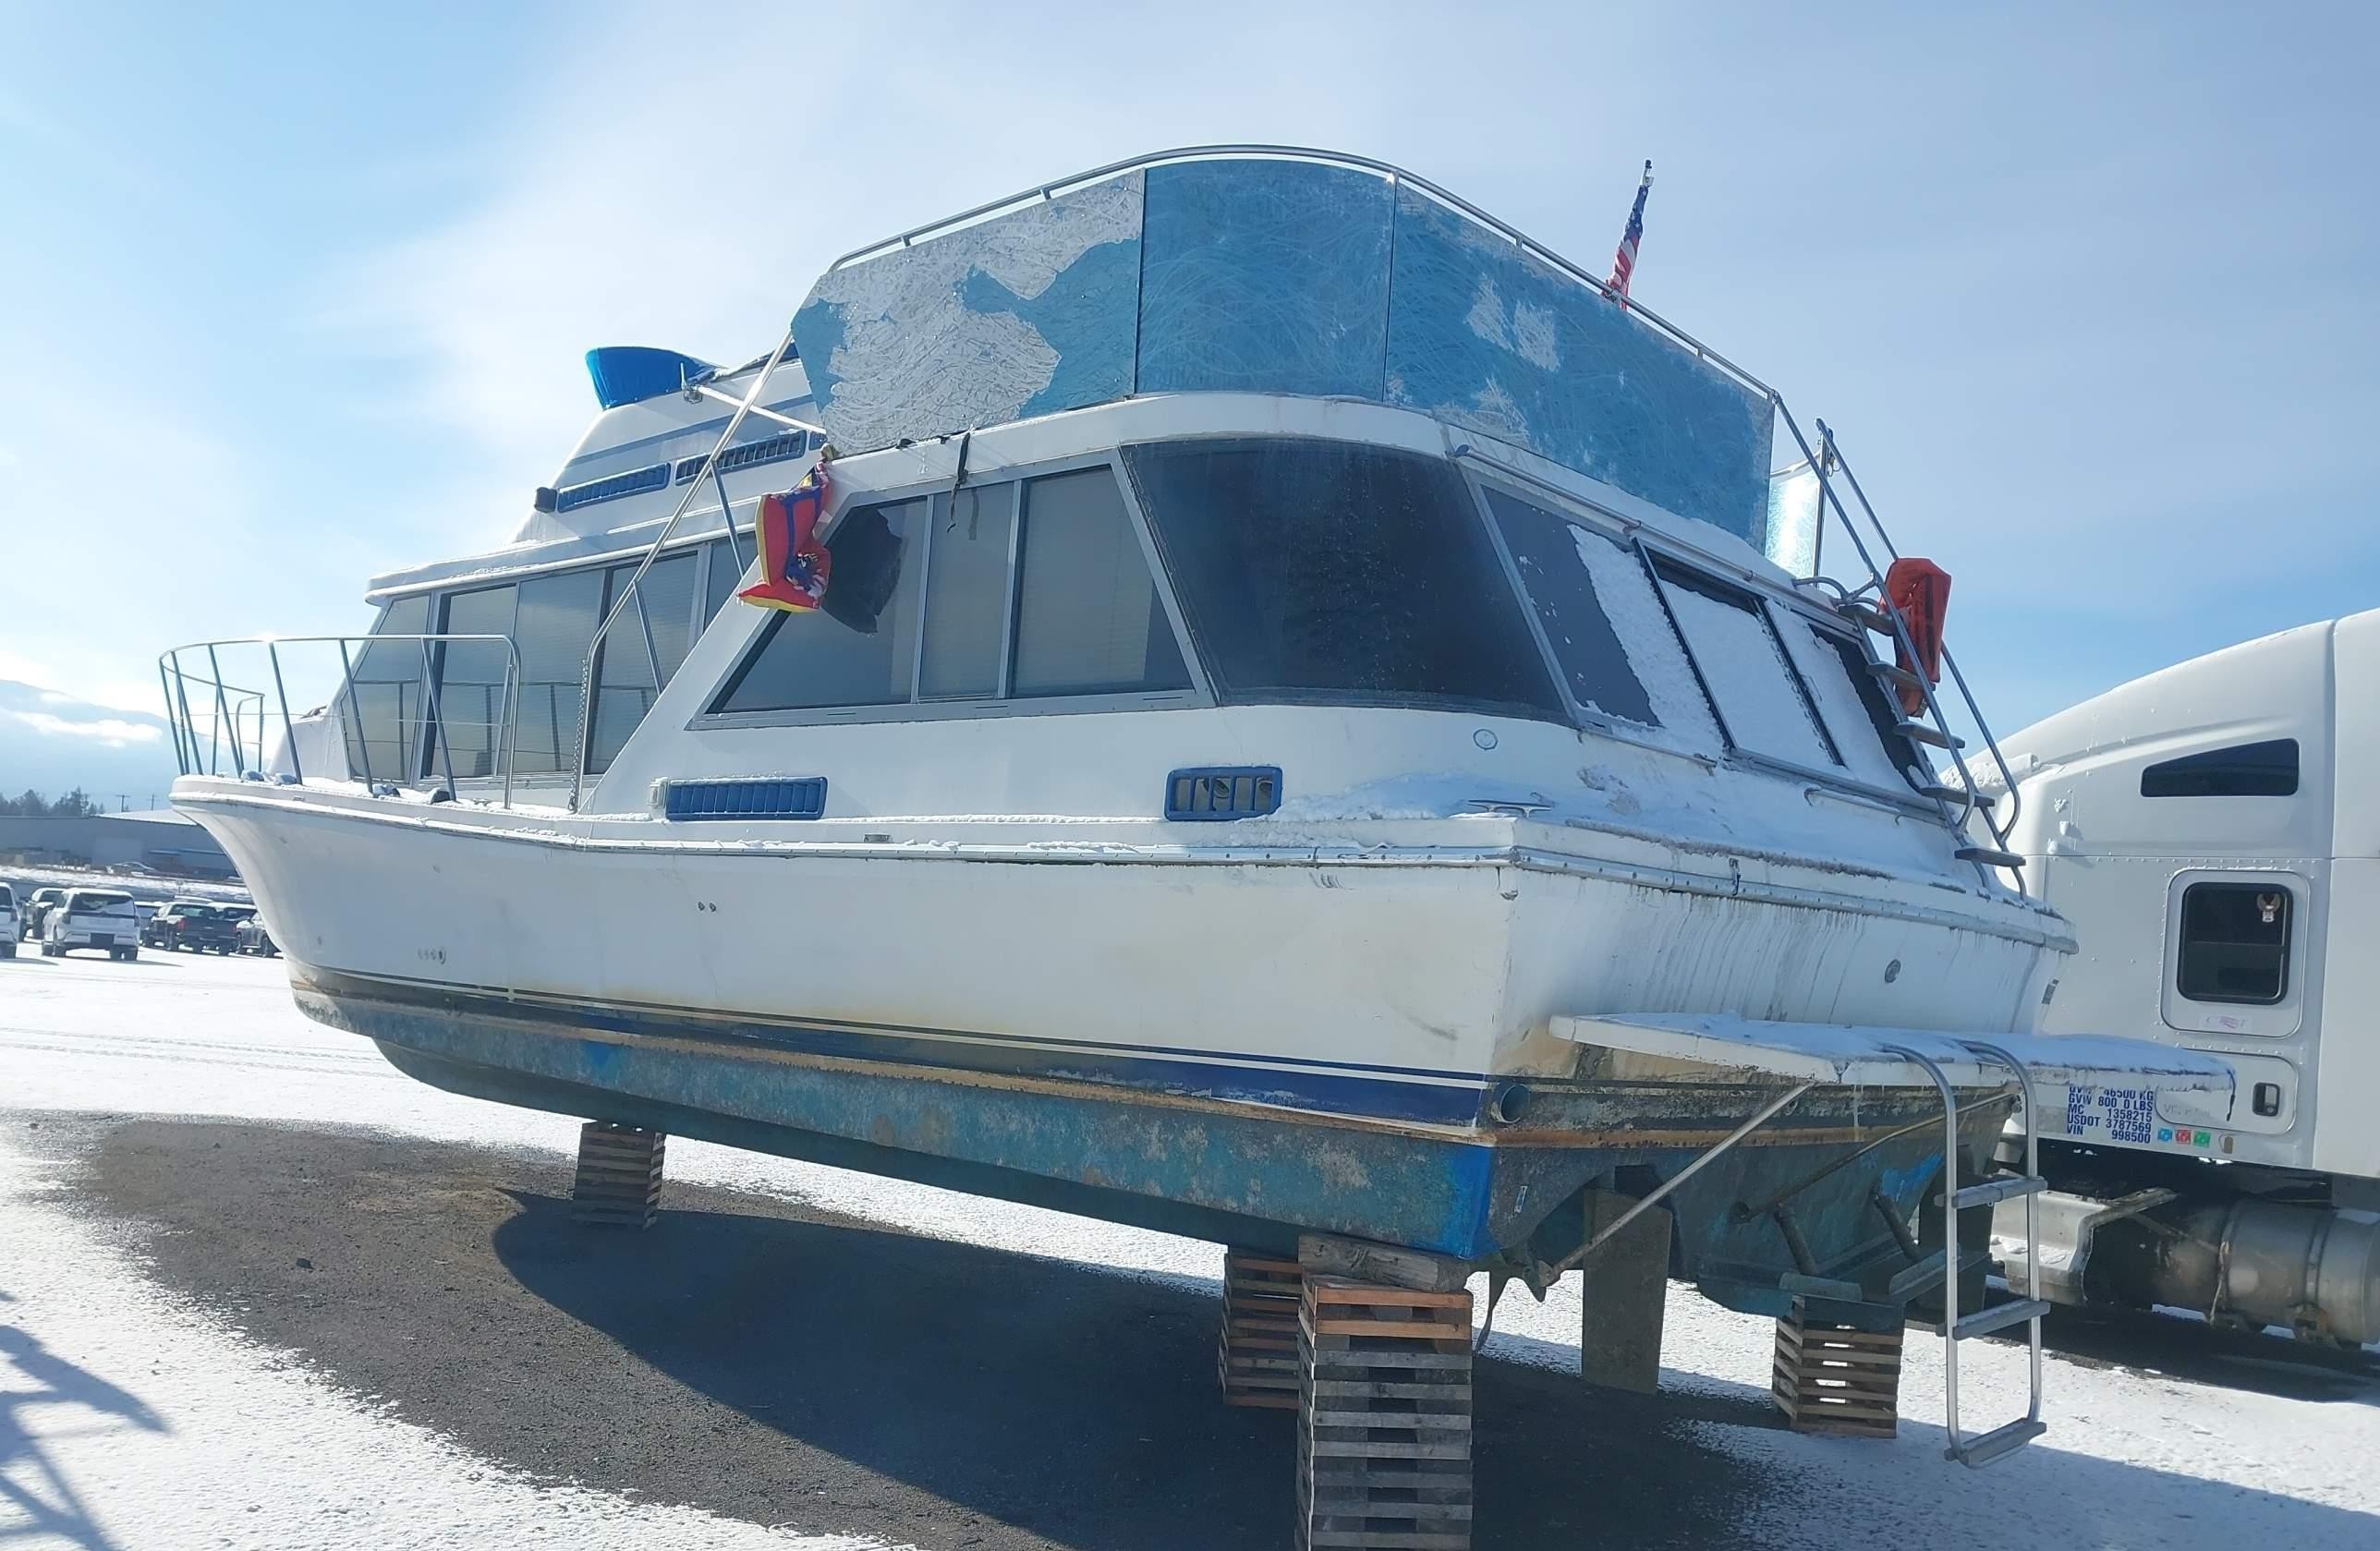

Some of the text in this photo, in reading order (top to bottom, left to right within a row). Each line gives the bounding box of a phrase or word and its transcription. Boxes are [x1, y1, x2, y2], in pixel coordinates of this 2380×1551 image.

[2069, 1093, 2092, 1105] GVW
[2133, 1100, 2154, 1111] LBS
[2068, 1104, 2084, 1114] MC
[2107, 1109, 2152, 1122] 1358215
[2067, 1114, 2152, 1133] USDOT 3787569
[2067, 1124, 2151, 1144] VIN 998500
